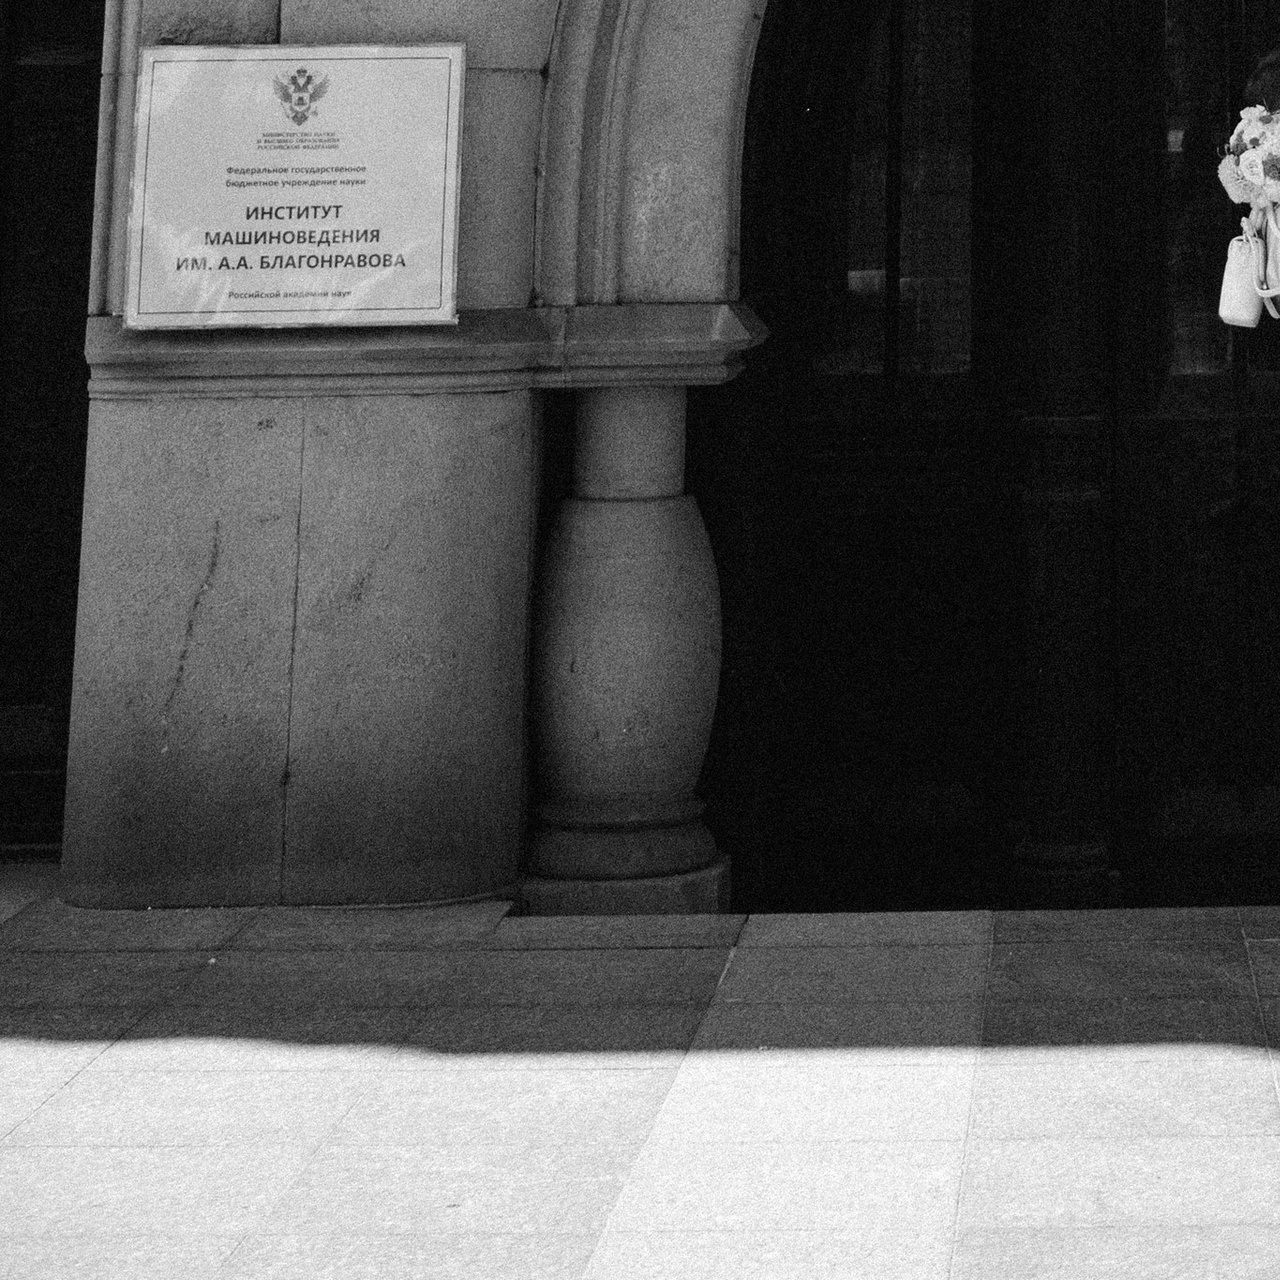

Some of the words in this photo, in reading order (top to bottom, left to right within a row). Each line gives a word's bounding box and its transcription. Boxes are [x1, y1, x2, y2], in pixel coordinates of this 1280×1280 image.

[226, 166, 289, 175] Федеральное
[291, 165, 367, 175] государственное
[225, 179, 279, 188] бюджетное
[281, 179, 338, 188] учреждение
[339, 178, 367, 187] науки
[245, 205, 343, 220] ИНСТИТУТ
[204, 229, 381, 247] МАШИНОВЕДЕНИЯ
[176, 256, 212, 271] ИМ.
[218, 255, 253, 270] А.А.
[259, 253, 406, 270] БЛАГОНРАВОВА
[228, 290, 281, 299] Российской
